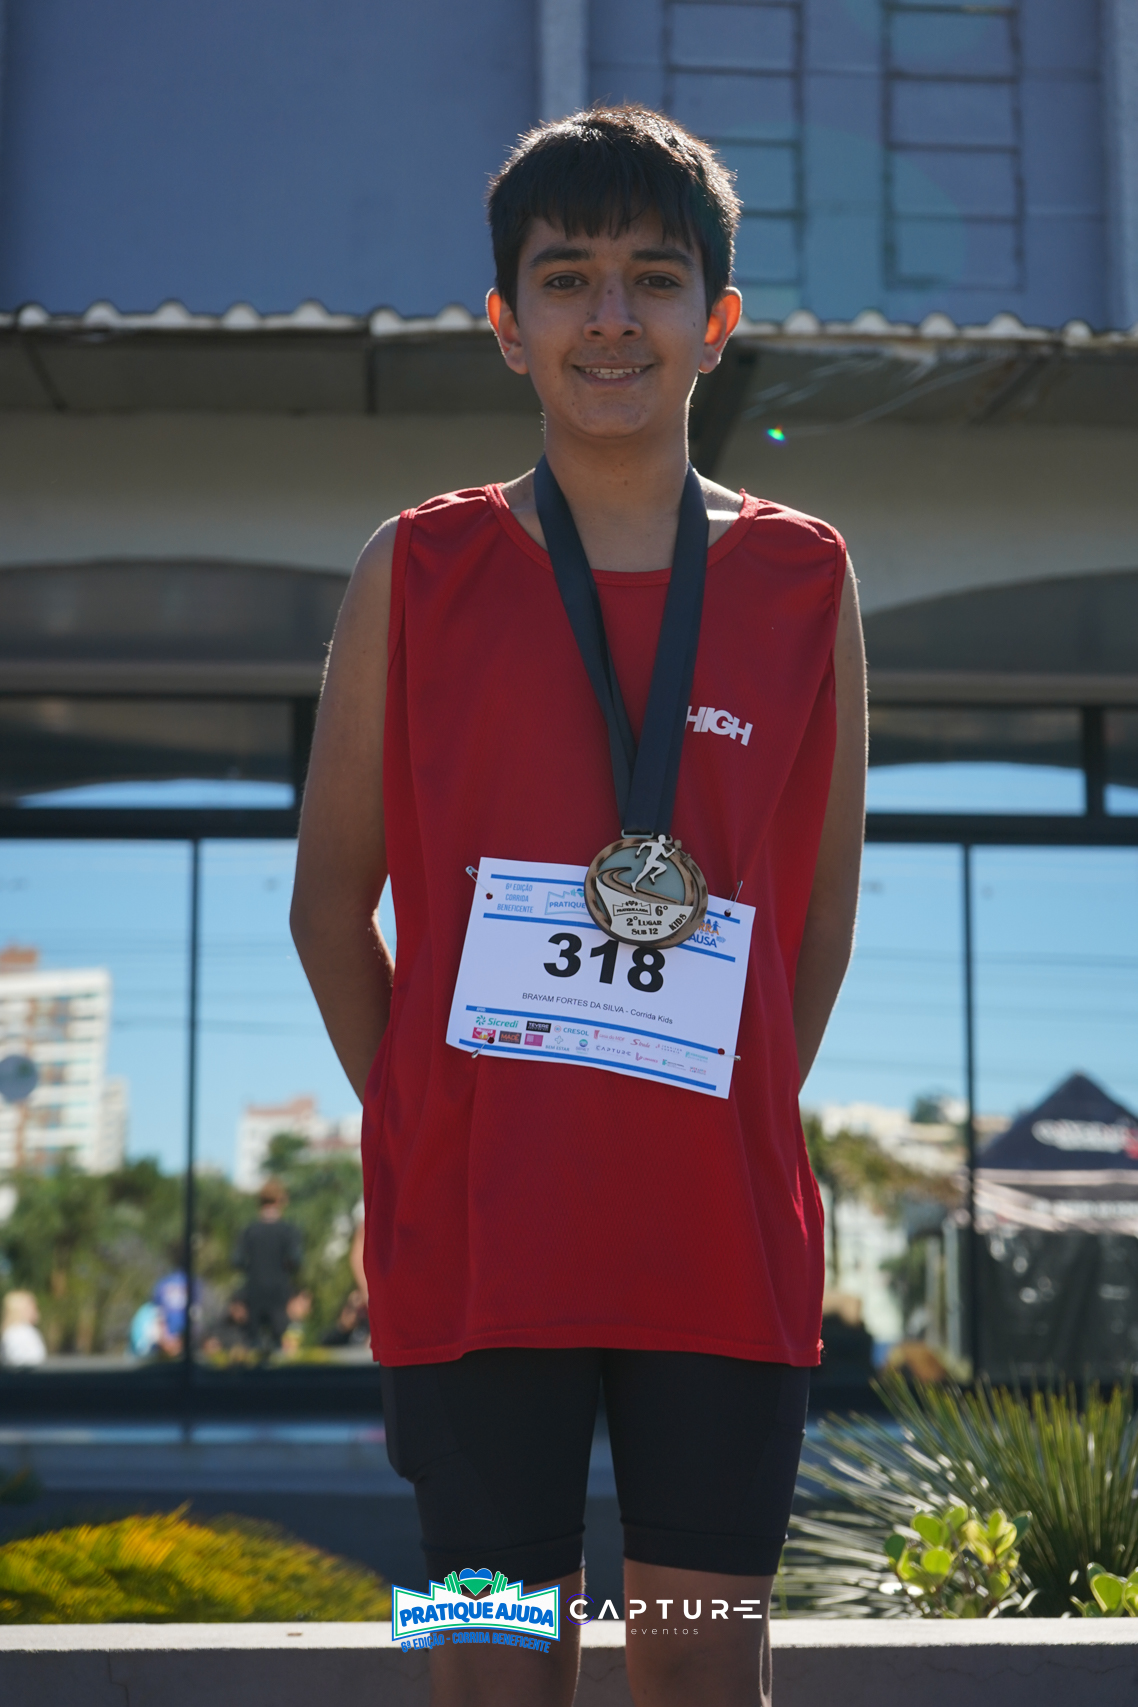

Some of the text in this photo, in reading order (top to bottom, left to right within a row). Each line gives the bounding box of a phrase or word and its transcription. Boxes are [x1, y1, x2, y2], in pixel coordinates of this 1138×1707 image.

[685, 706, 753, 746] HIGH
[513, 883, 533, 892] EDIÇÃO
[505, 893, 529, 902] CORRIDA
[497, 903, 534, 913] BENEFICENTE
[549, 901, 586, 909] PRATIQUE
[668, 913, 687, 931] KIDS
[688, 932, 717, 948] AUSA
[543, 932, 666, 993] 318
[522, 992, 555, 1003] BRAYAM
[556, 996, 588, 1007] FORTES
[590, 1001, 602, 1009] DA
[603, 1003, 624, 1013] SILVA
[630, 1009, 656, 1020] Corrida
[658, 1015, 673, 1025] Kids
[487, 1017, 519, 1028] Sicredi
[563, 1027, 589, 1036] CRESOL
